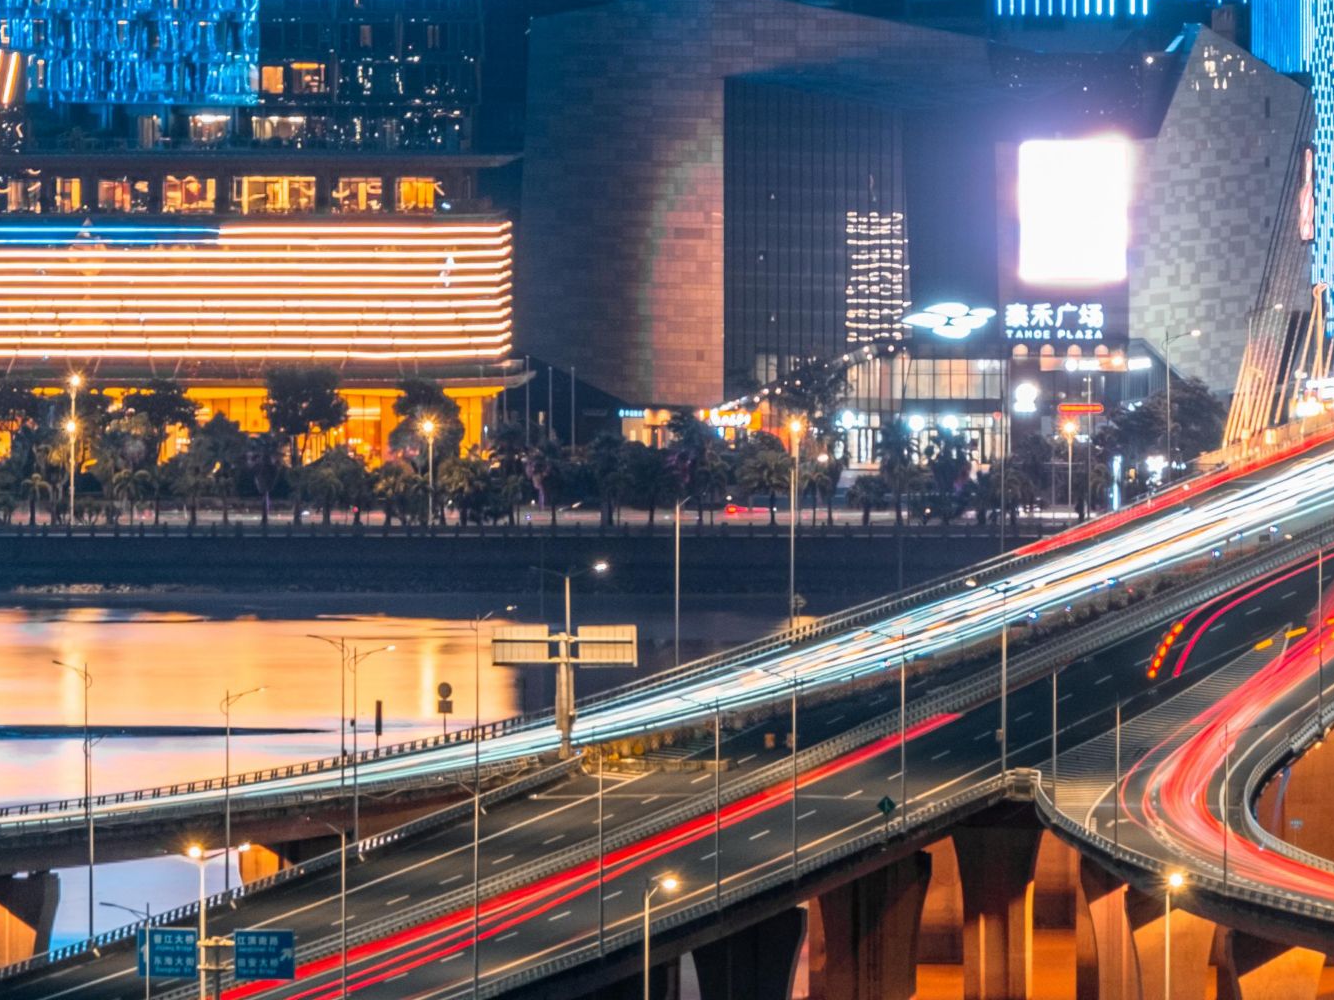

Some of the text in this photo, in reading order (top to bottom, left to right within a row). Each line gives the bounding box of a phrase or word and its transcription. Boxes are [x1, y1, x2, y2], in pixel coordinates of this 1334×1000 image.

[1005, 303, 1104, 328] 泰禾广场
[1005, 329, 1103, 339] TAHOE PLAZA
